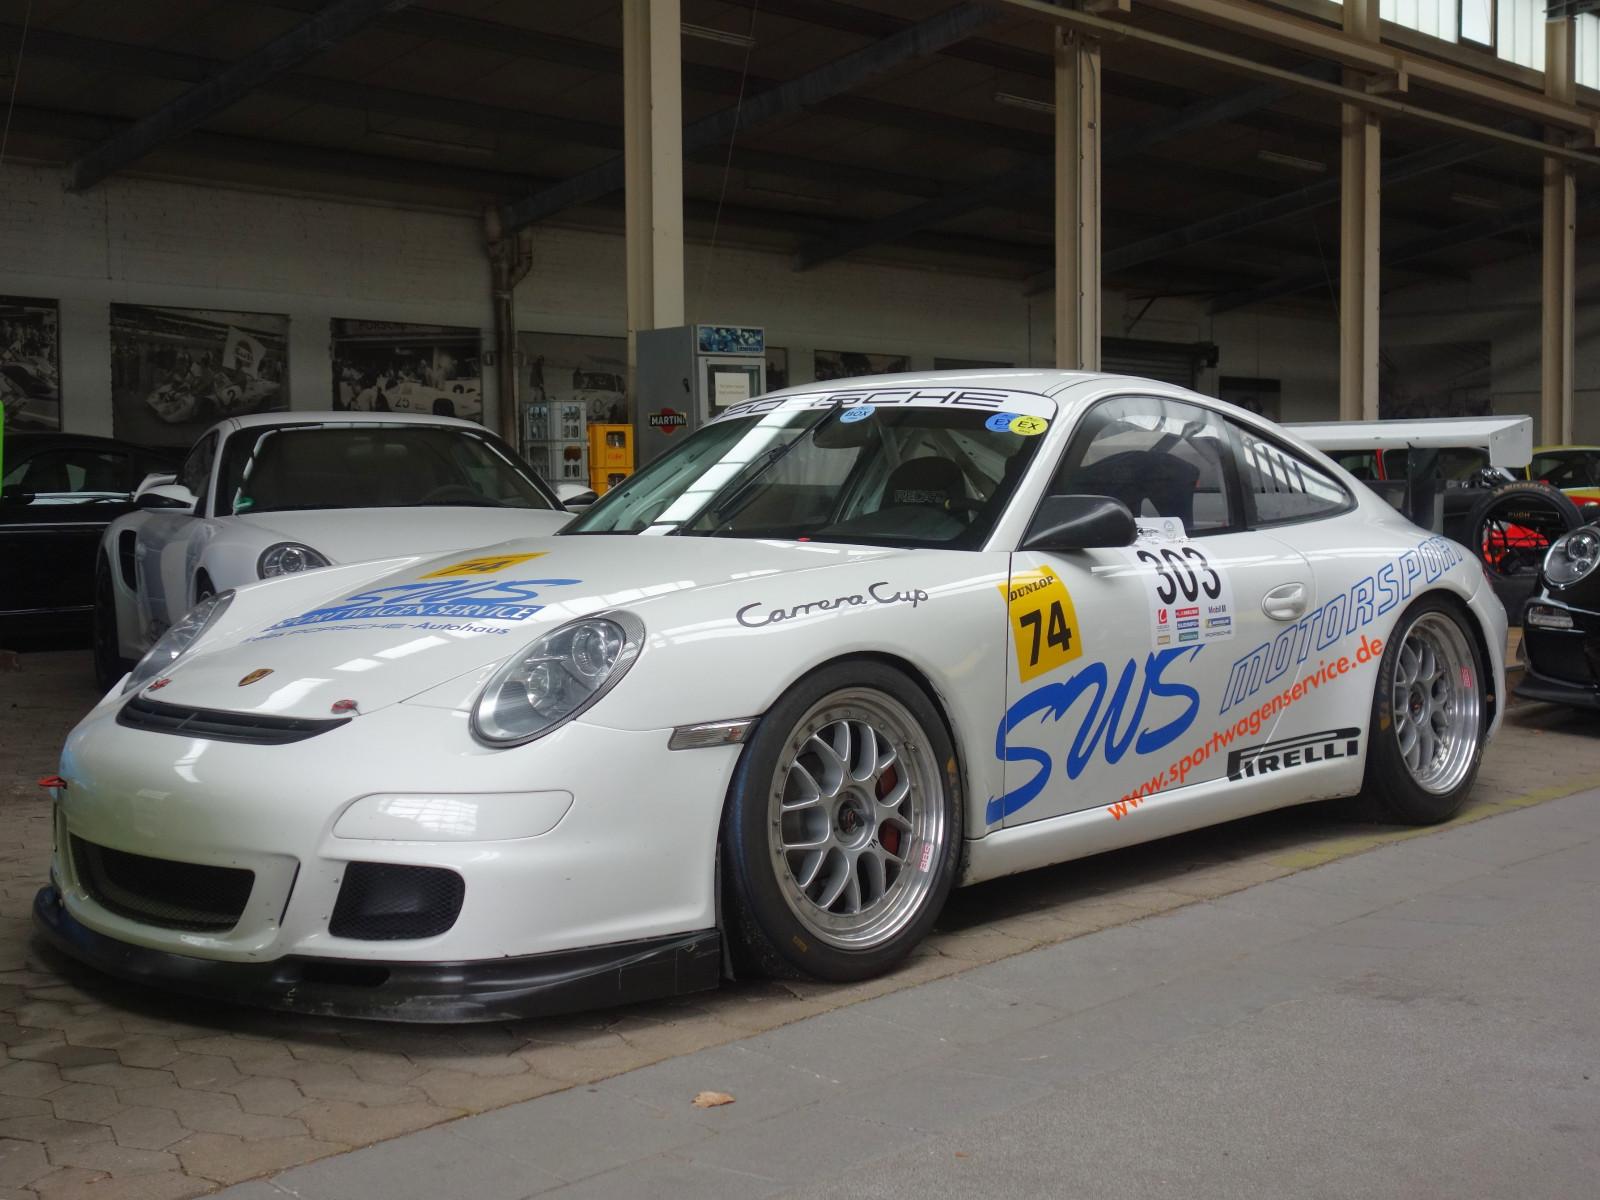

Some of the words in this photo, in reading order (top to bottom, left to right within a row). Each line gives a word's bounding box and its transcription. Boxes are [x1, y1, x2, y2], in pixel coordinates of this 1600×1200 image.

[845, 409, 871, 417] BOX
[1017, 420, 1039, 430] EX
[335, 578, 583, 607] SWS
[1010, 575, 1054, 602] DUNLOP
[1136, 547, 1222, 605] 303
[736, 594, 867, 628] Carrera
[868, 581, 929, 608] Cup
[1219, 535, 1463, 716] MOTORSPORT
[1019, 600, 1072, 667] 74
[986, 644, 1205, 825] SWS
[1107, 635, 1384, 821] www.sportwagenservice.de
[1226, 726, 1361, 782] PIRELLI
